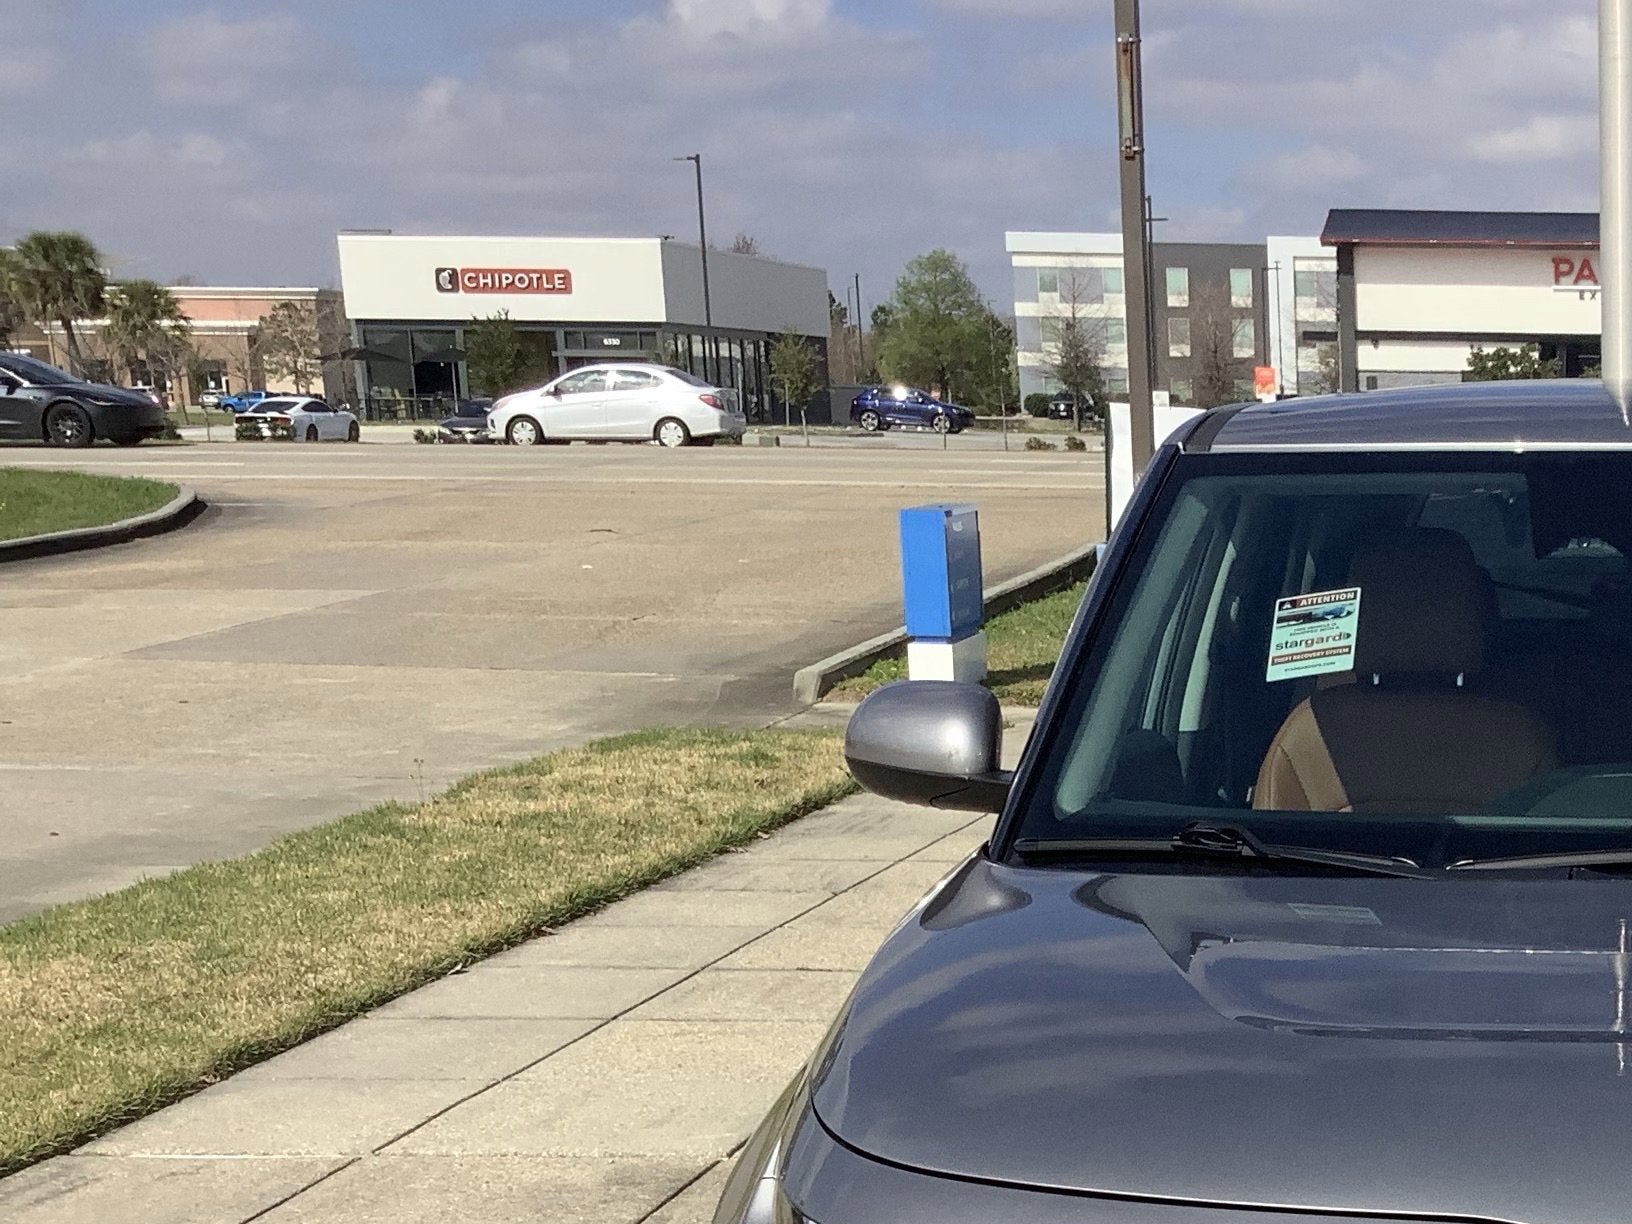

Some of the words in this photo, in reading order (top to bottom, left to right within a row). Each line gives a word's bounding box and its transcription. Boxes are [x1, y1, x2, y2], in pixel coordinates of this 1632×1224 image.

[463, 272, 567, 289] CHIPOTLE
[1300, 592, 1355, 606] ATTENTION
[1275, 632, 1344, 650] stargard
[1274, 654, 1292, 663] THEFT
[1292, 651, 1325, 661] RECOVERY
[1325, 647, 1350, 656] SYSTEM
